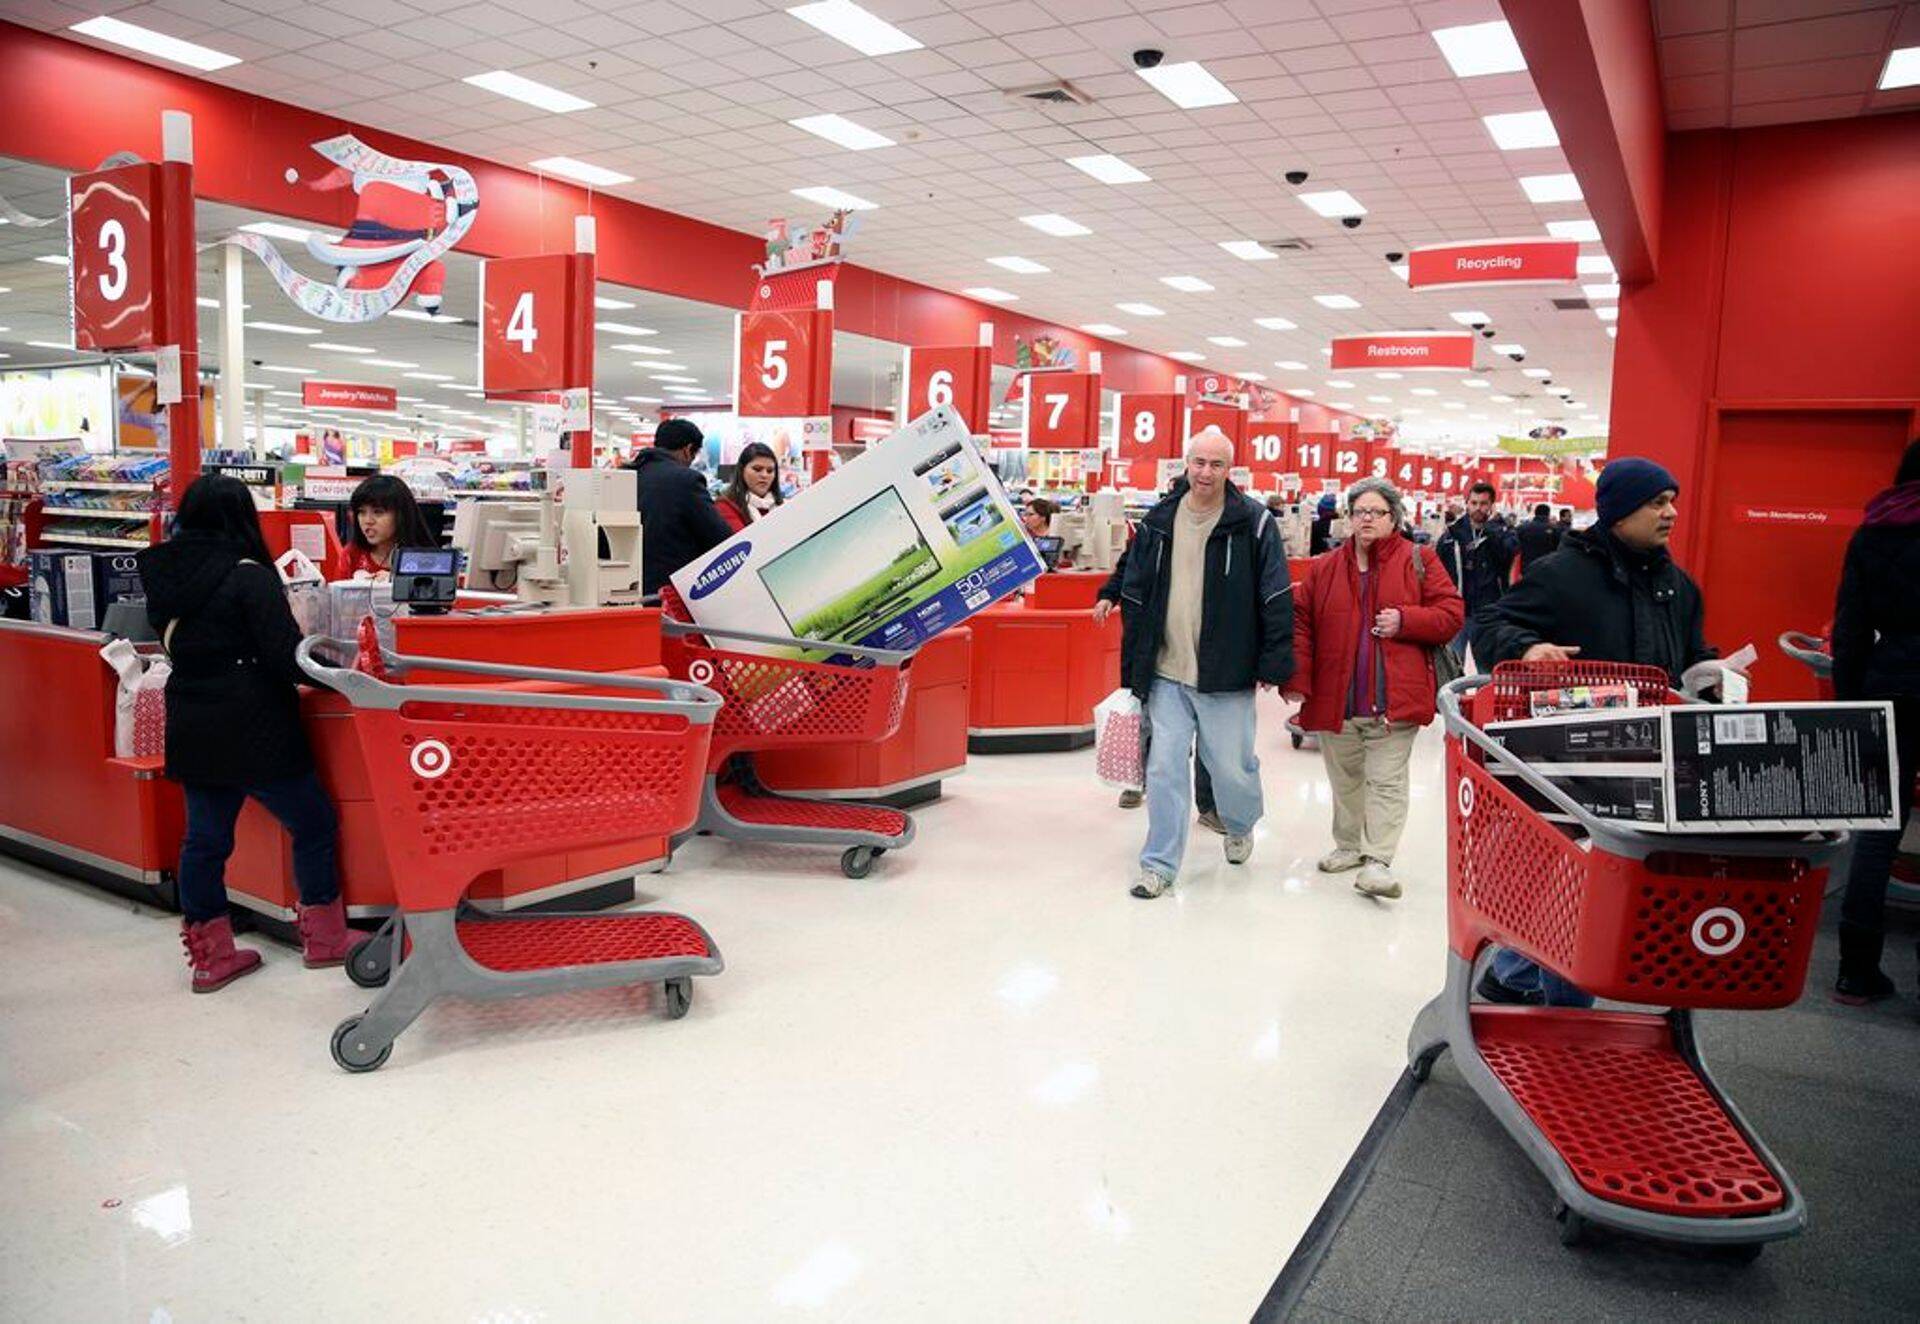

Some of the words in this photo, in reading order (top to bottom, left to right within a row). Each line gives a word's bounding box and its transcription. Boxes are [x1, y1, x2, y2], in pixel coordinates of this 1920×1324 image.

[98, 219, 128, 301] 3
[1456, 255, 1522, 270] Recycling
[506, 292, 538, 353] 4
[761, 340, 788, 389] 5
[1367, 344, 1429, 356] Restroom
[928, 370, 953, 407] 6
[1045, 394, 1069, 429] 7
[1134, 411, 1156, 443] 8
[1252, 434, 1281, 461] 10
[1297, 444, 1321, 467] 11
[1336, 451, 1358, 473] 12
[1808, 512, 1827, 522] Only
[696, 550, 748, 590] SAMSUNG
[1699, 779, 1710, 818] SONY
